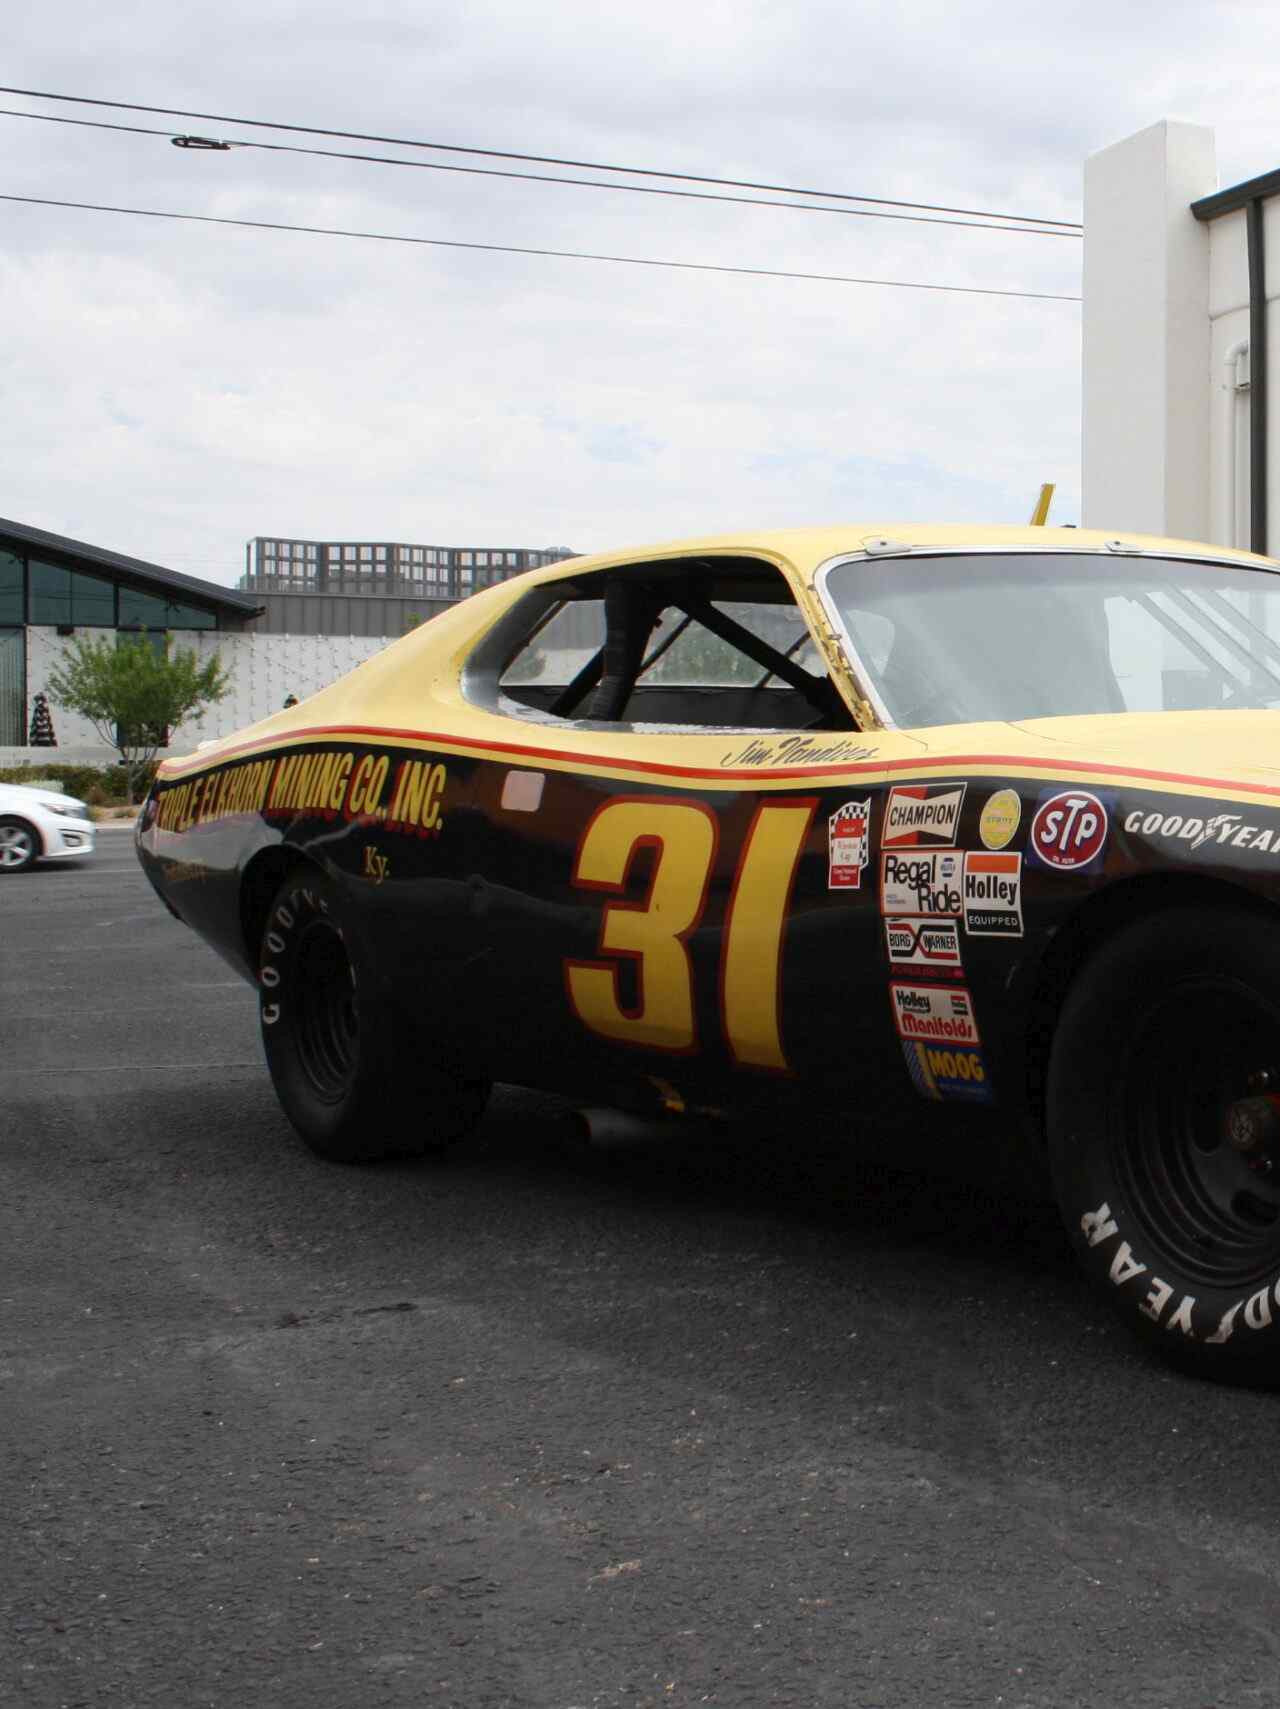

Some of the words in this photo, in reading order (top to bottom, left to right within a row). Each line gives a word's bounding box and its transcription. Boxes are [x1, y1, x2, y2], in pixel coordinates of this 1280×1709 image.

[200, 759, 276, 824] ELKHORN
[269, 752, 353, 812] MINING
[391, 760, 446, 832] INC.
[890, 800, 955, 826] CHAMPION
[1040, 799, 1098, 850] STP
[884, 855, 936, 889] Regal
[918, 882, 961, 912] Ride
[966, 875, 1018, 905] Holley
[563, 794, 820, 1077] 31
[968, 915, 1018, 926] EQUIPPED
[889, 932, 911, 947] BORG
[922, 934, 957, 950] WARNER
[896, 990, 931, 1012] Holley
[901, 1013, 972, 1038] Manifolds
[927, 1050, 985, 1081] MOOG
